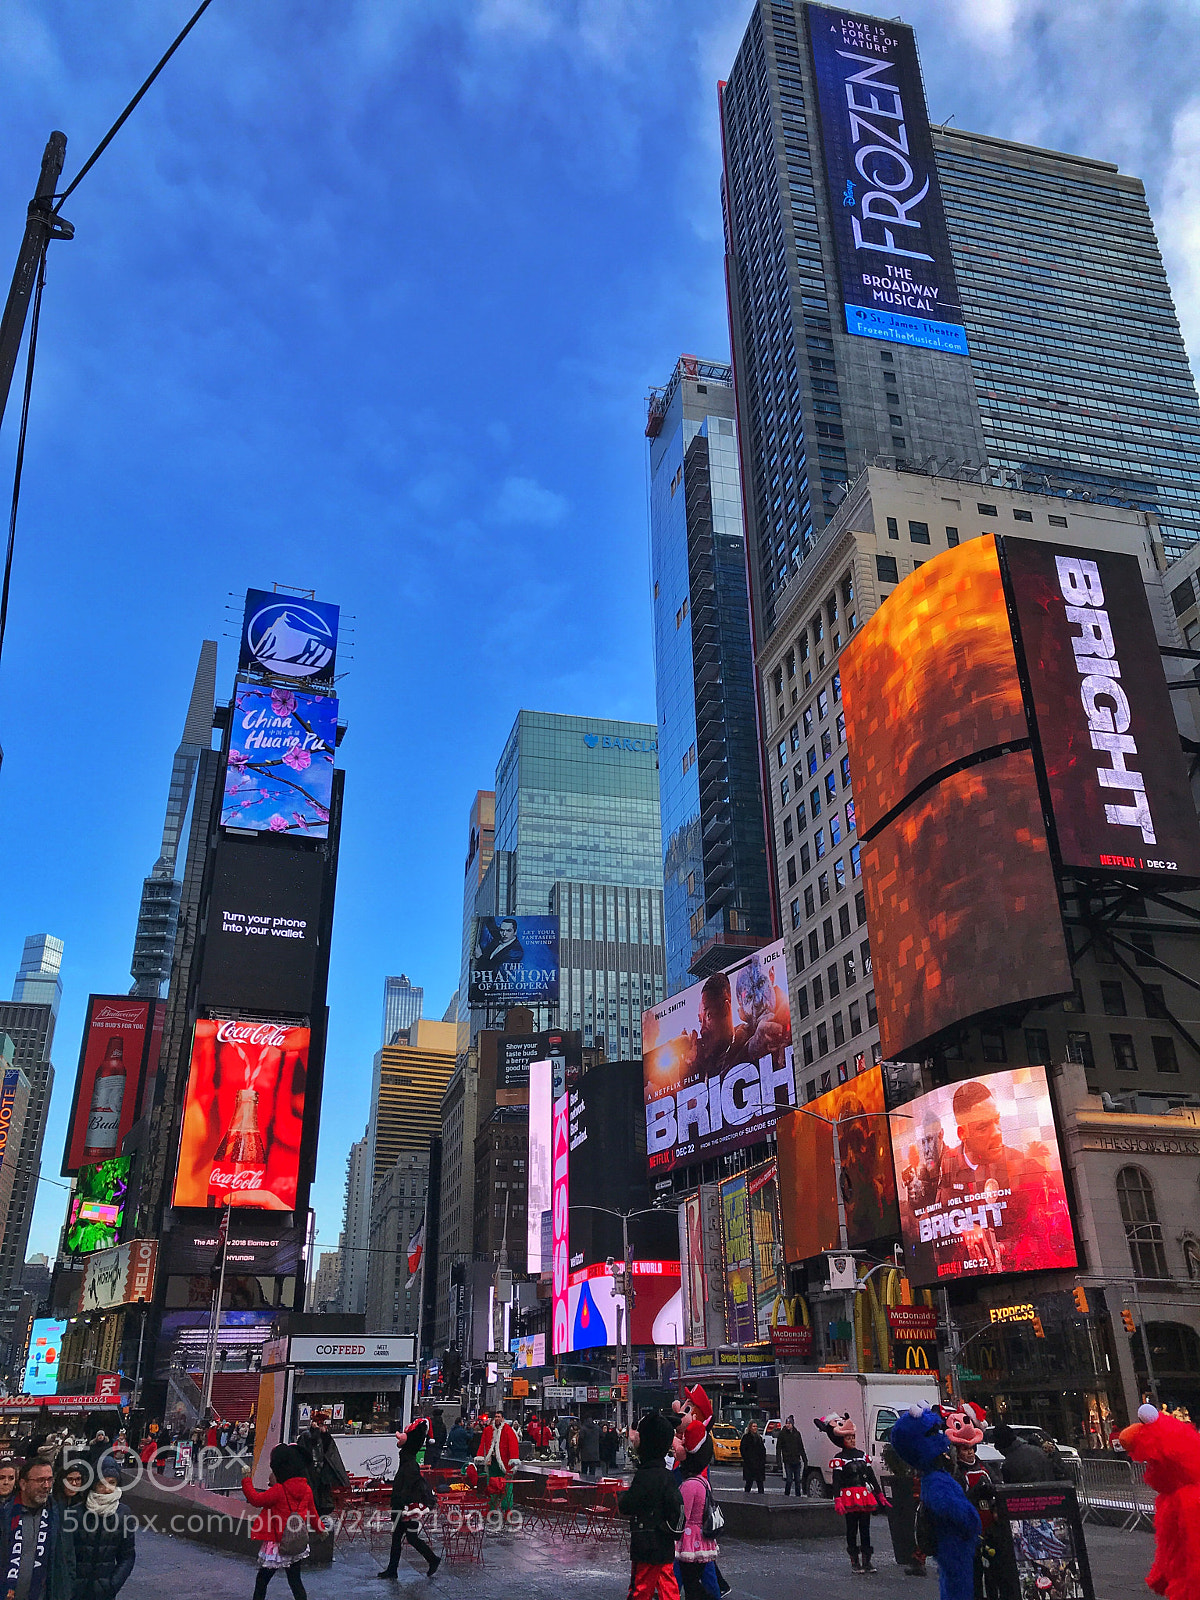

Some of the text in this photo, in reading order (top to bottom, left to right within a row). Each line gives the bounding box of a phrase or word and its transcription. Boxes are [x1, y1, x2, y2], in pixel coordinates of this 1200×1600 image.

[841, 19, 885, 36] LOVE IS
[842, 28, 878, 42] FORCE
[884, 38, 899, 46] OF
[844, 37, 888, 54] NATURE
[834, 49, 936, 262] FROZEN
[842, 180, 856, 208] Disney
[885, 265, 913, 280] THE
[862, 274, 938, 299] BROADWAY
[872, 289, 934, 312] MUSICAL
[870, 313, 960, 338] St. James Theatre
[857, 322, 962, 350] FrozenTheMusical.com
[1054, 555, 1157, 845] BRIGHT
[242, 709, 292, 730] China
[1100, 855, 1178, 870] NETFLIX DEC 22
[223, 912, 306, 928] Turn your phone
[223, 922, 305, 938] into your wallet.
[502, 962, 524, 970] THE
[763, 951, 780, 964] JOEL
[470, 970, 556, 984] PHANTOM
[478, 982, 548, 991] OF THE OPERA
[102, 1009, 138, 1018] Budweiser
[654, 1000, 686, 1021] WILL SMITH
[506, 1064, 520, 1072] good
[654, 1080, 681, 1098] NETFLIX
[684, 1074, 700, 1085] FILM
[720, 1133, 738, 1143] DIRECTOR
[744, 1122, 766, 1135] SUICIDE
[767, 1116, 783, 1128] SQU
[1100, 1138, 1200, 1153] THE SHOW FOLKS
[649, 1144, 695, 1168] NETFLIX DEC 22
[914, 1188, 1012, 1217] WILL SMITH JOEL EDGERTON
[918, 1201, 1008, 1243] BRIGHT
[942, 1236, 964, 1246] NETFLIX
[134, 1243, 152, 1299] HELLO!
[639, 1262, 662, 1274] WORLD
[937, 1258, 988, 1277] NETFLIX DEC 22
[890, 1312, 936, 1320] McDonald's
[990, 1304, 1034, 1323] EXPRESS
[316, 1345, 366, 1354] COFFEED
